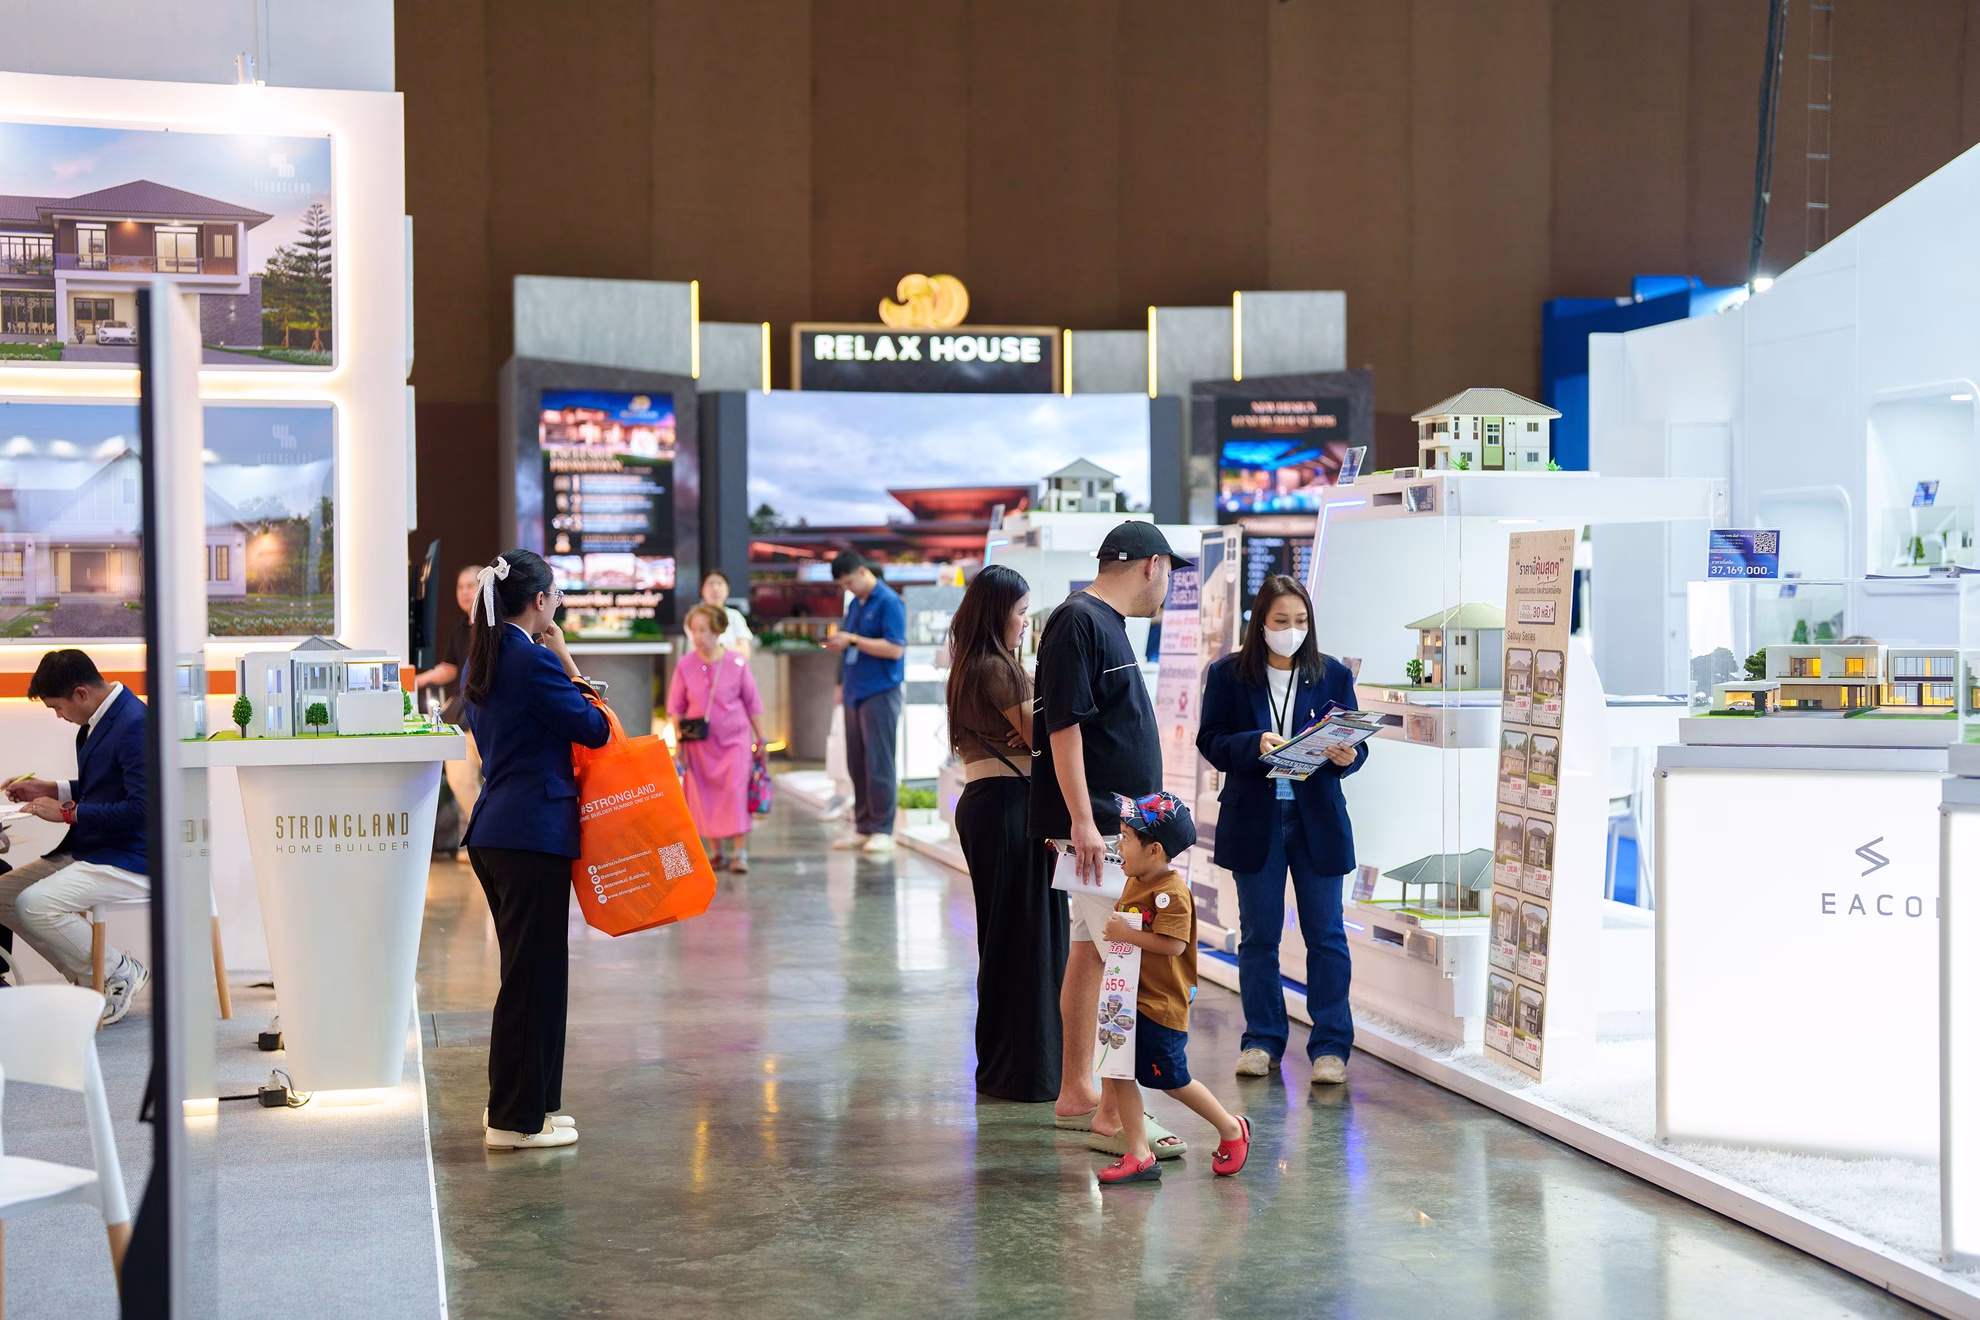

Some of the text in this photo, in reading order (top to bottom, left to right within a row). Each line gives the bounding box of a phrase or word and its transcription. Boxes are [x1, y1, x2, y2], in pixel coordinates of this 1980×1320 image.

[814, 334, 1041, 363] RELAX HOUSE
[1522, 630, 1536, 641] Series
[581, 783, 656, 815] #STRONGLAND
[591, 807, 612, 818] BUILDER
[613, 801, 634, 811] NUMBER
[275, 811, 409, 839] STRONGLAND
[276, 841, 409, 853] HOME BUILDER
[1821, 892, 1940, 919] EACO
